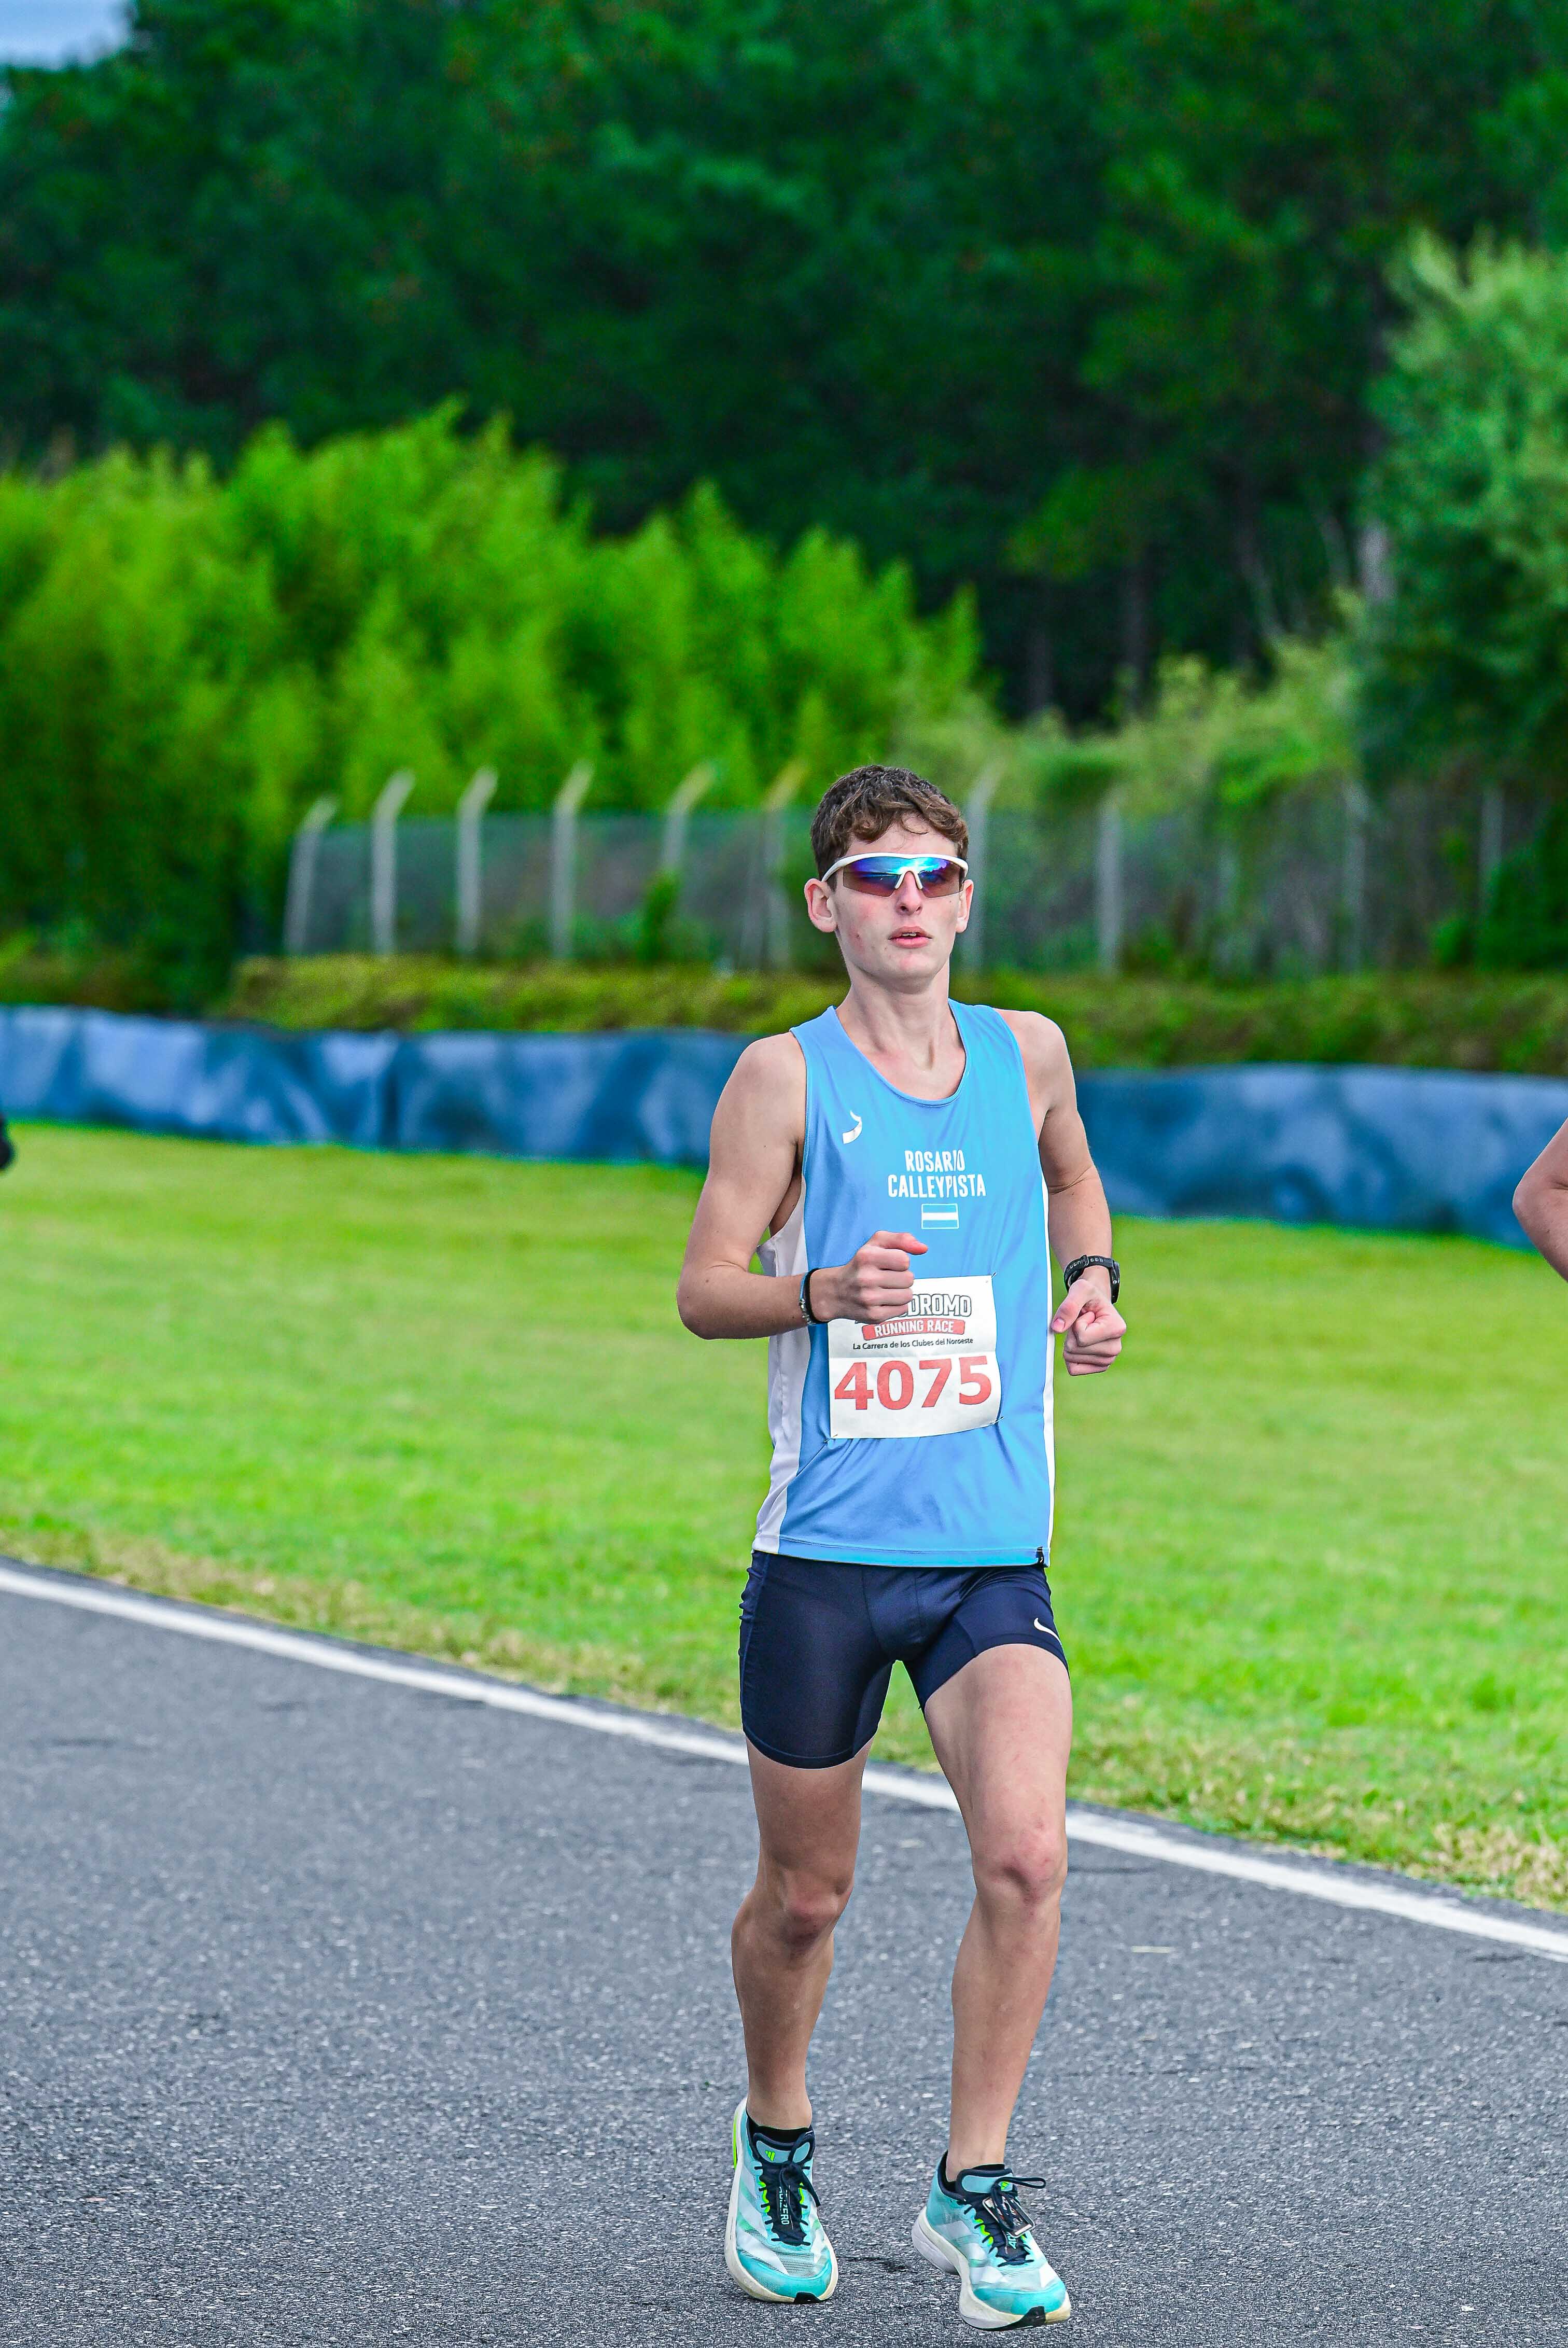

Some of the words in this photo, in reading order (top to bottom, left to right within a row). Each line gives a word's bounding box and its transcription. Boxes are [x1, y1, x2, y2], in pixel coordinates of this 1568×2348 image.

[904, 1150, 965, 1172] ROSARIO
[888, 1174, 986, 1198] CALLEYPISTA
[899, 1293, 972, 1318] DROMO
[874, 1319, 923, 1337] RUNNING
[927, 1320, 955, 1333] RACE
[834, 1355, 992, 1410] 4075
